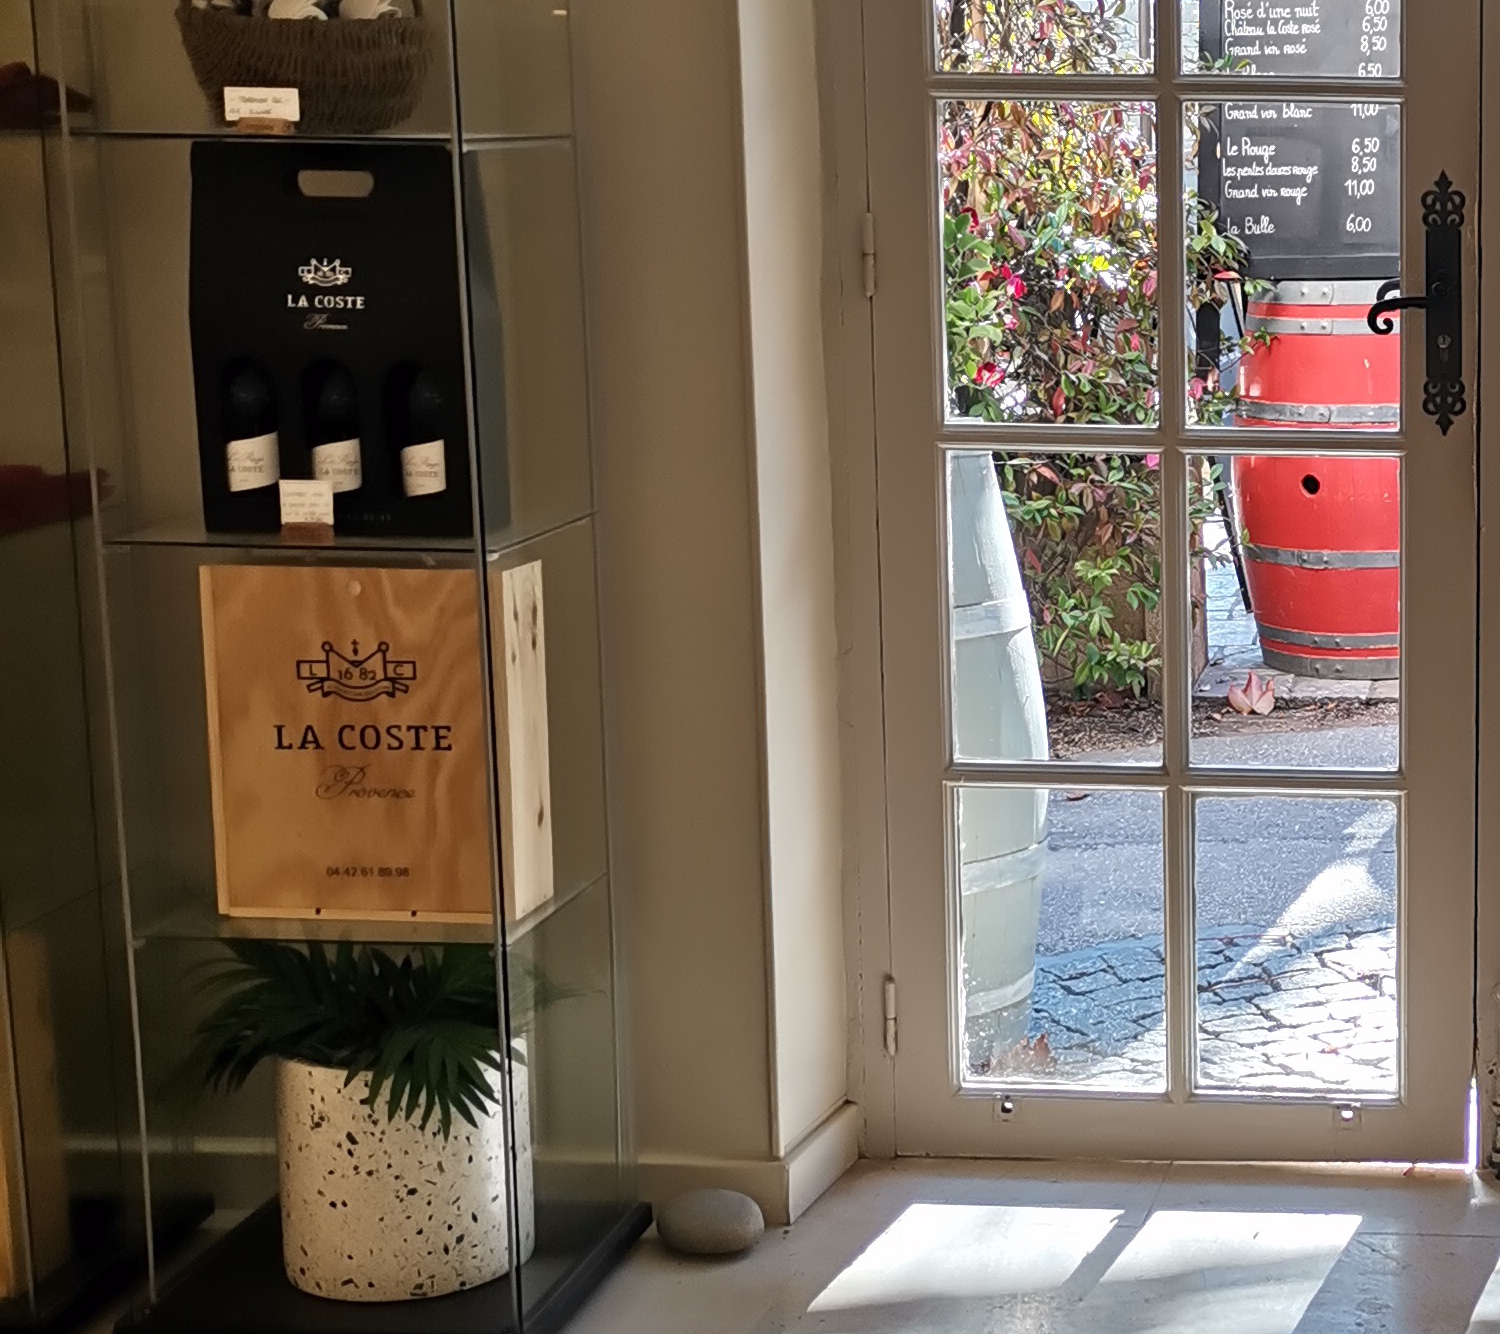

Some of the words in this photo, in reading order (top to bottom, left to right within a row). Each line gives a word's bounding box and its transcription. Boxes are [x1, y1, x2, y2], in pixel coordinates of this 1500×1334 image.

[1256, 1, 1292, 19] d'une
[1294, 0, 1321, 18] nuit
[1224, 19, 1265, 36] Château
[1362, 16, 1388, 35] 6,50
[1225, 38, 1262, 56] Grand
[1264, 40, 1281, 55] vin
[1360, 35, 1387, 56] 8,50
[1225, 103, 1259, 120] Grand
[1282, 103, 1313, 119] blanc
[1241, 137, 1276, 164] Rouge
[1351, 137, 1380, 156] 6,50
[1351, 156, 1377, 175] 8,50
[1225, 180, 1260, 198] Grand
[1261, 185, 1279, 198] vin
[1344, 179, 1375, 199] 11,00
[1244, 216, 1276, 235] Bulle
[1346, 213, 1372, 234] 6,00
[286, 294, 310, 308] LA
[314, 295, 366, 309] COSTE
[273, 724, 325, 750] LA
[337, 724, 453, 751] COSTE
[315, 764, 416, 801] Provence
